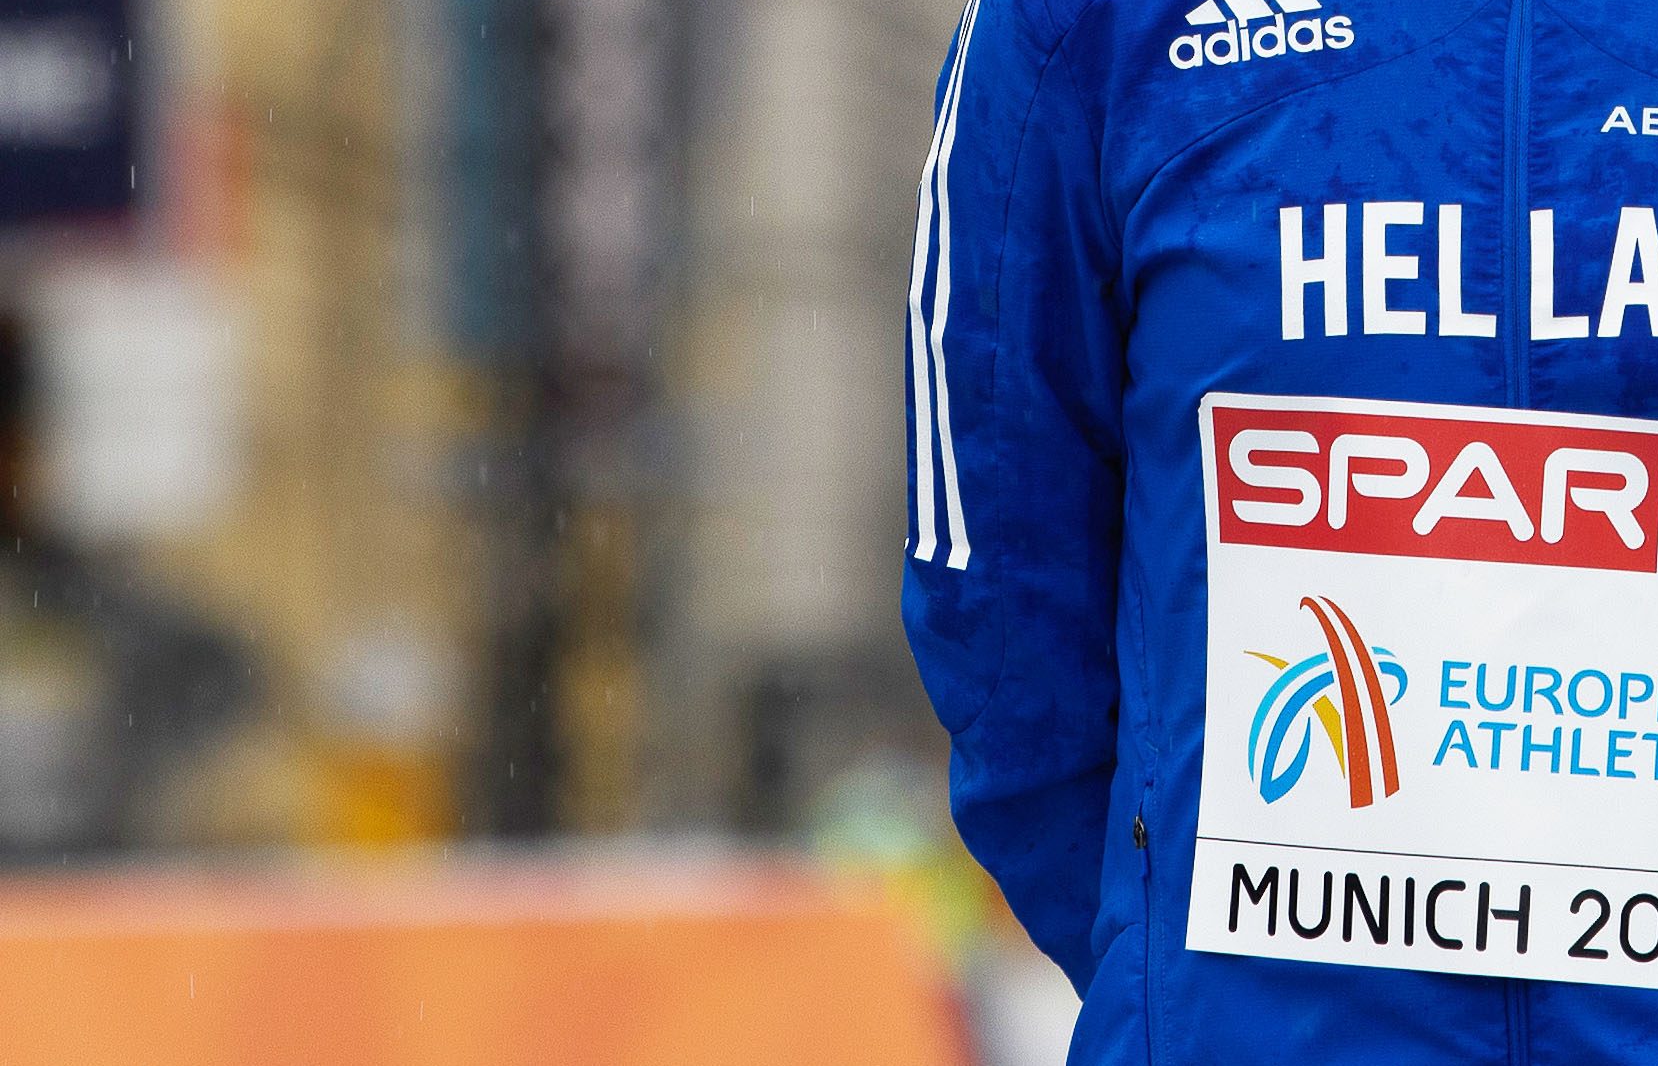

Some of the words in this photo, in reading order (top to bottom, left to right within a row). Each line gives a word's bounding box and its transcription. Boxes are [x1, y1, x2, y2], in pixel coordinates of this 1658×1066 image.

[1169, 9, 1355, 70] adidas
[1228, 428, 1649, 550] SPAR
[1228, 862, 1531, 955] MUNICH
